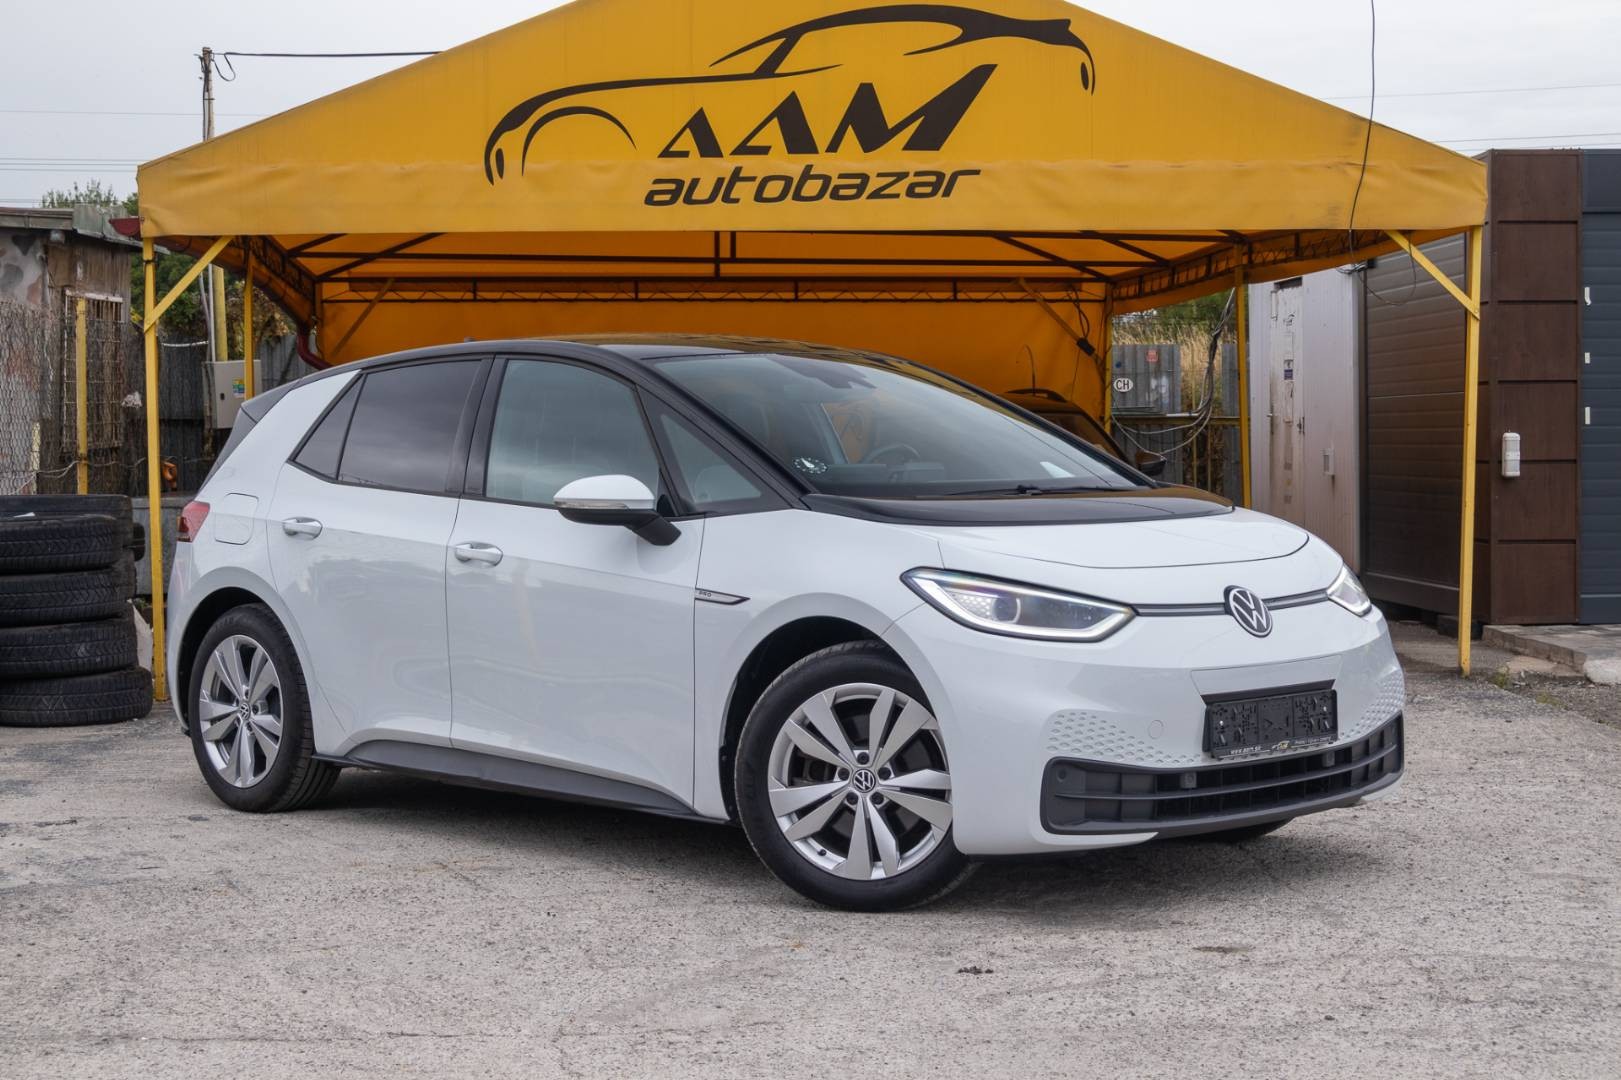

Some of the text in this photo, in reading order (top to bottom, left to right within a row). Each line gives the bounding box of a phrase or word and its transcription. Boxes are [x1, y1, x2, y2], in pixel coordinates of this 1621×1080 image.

[657, 64, 997, 158] AAM
[644, 164, 981, 206] autobazar
[1116, 379, 1130, 390] CH
